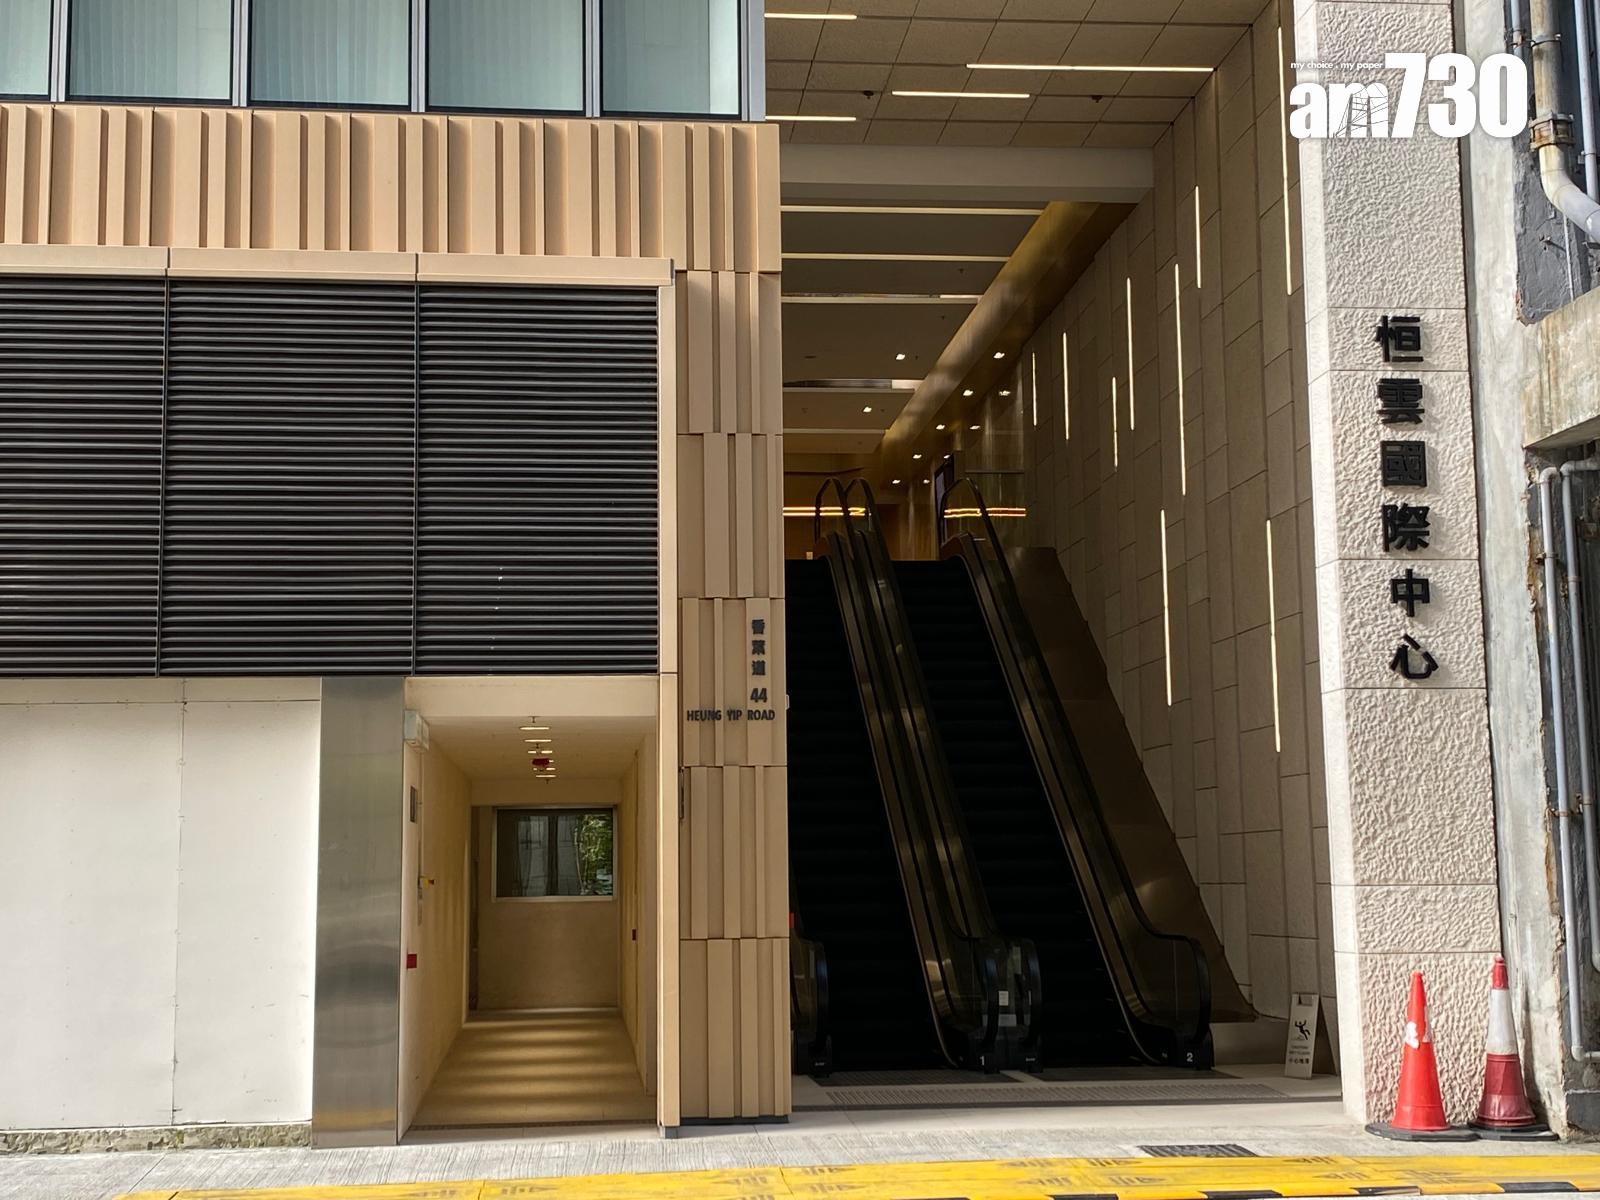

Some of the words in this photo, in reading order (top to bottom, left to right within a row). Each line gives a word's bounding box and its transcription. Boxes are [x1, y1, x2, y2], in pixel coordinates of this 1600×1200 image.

[1376, 315, 1438, 679] 恒雲國際中心
[750, 688, 767, 703] 44
[686, 710, 722, 721] HEUNG
[727, 710, 743, 720] YIP
[747, 710, 776, 721] ROAD
[1186, 1052, 1194, 1062] 2
